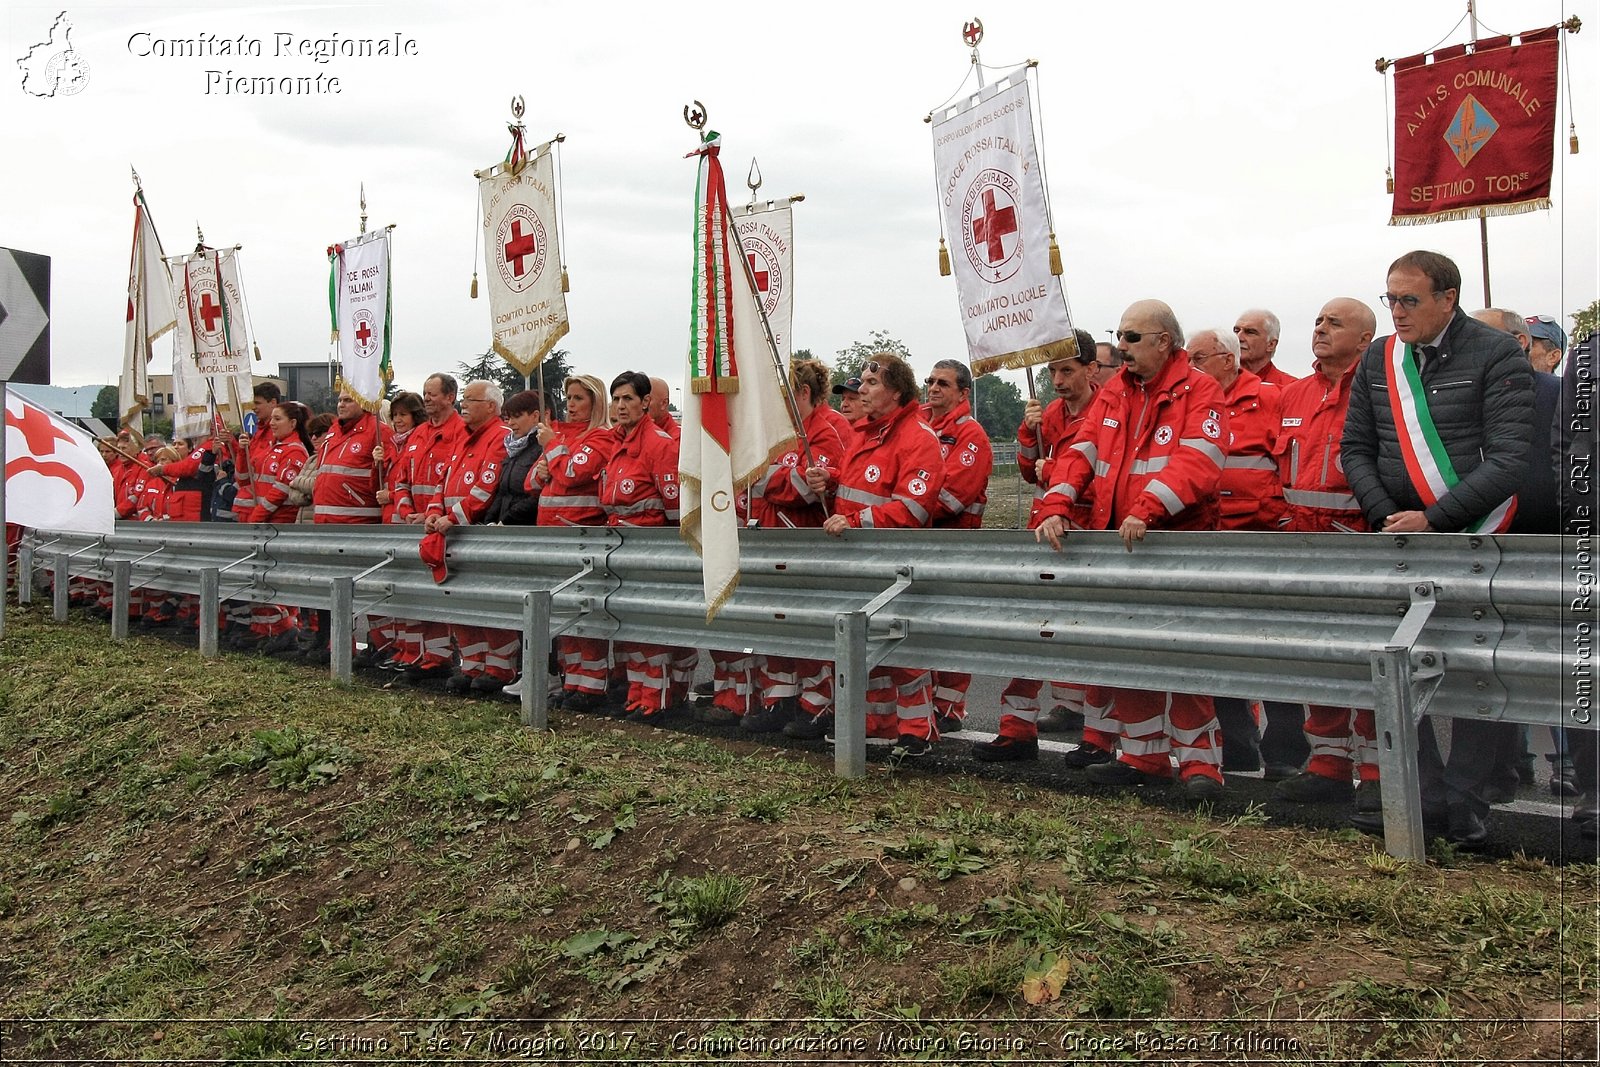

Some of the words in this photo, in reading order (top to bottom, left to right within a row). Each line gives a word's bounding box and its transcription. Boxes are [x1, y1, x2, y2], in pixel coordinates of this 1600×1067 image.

[1454, 70, 1541, 117] COMUNALE
[945, 159, 966, 207] CROCE
[964, 137, 993, 163] ROSSA
[1002, 177, 1013, 190] 22
[1410, 178, 1475, 203] SETTIMO
[534, 220, 546, 256] AGOSTO
[759, 223, 788, 256] ITALIANA
[762, 246, 772, 259] 22
[769, 258, 780, 296] AGOSTO
[696, 269, 709, 319] ROSSA
[1012, 285, 1047, 306] LOCALE
[982, 309, 1034, 333] LAURIANO
